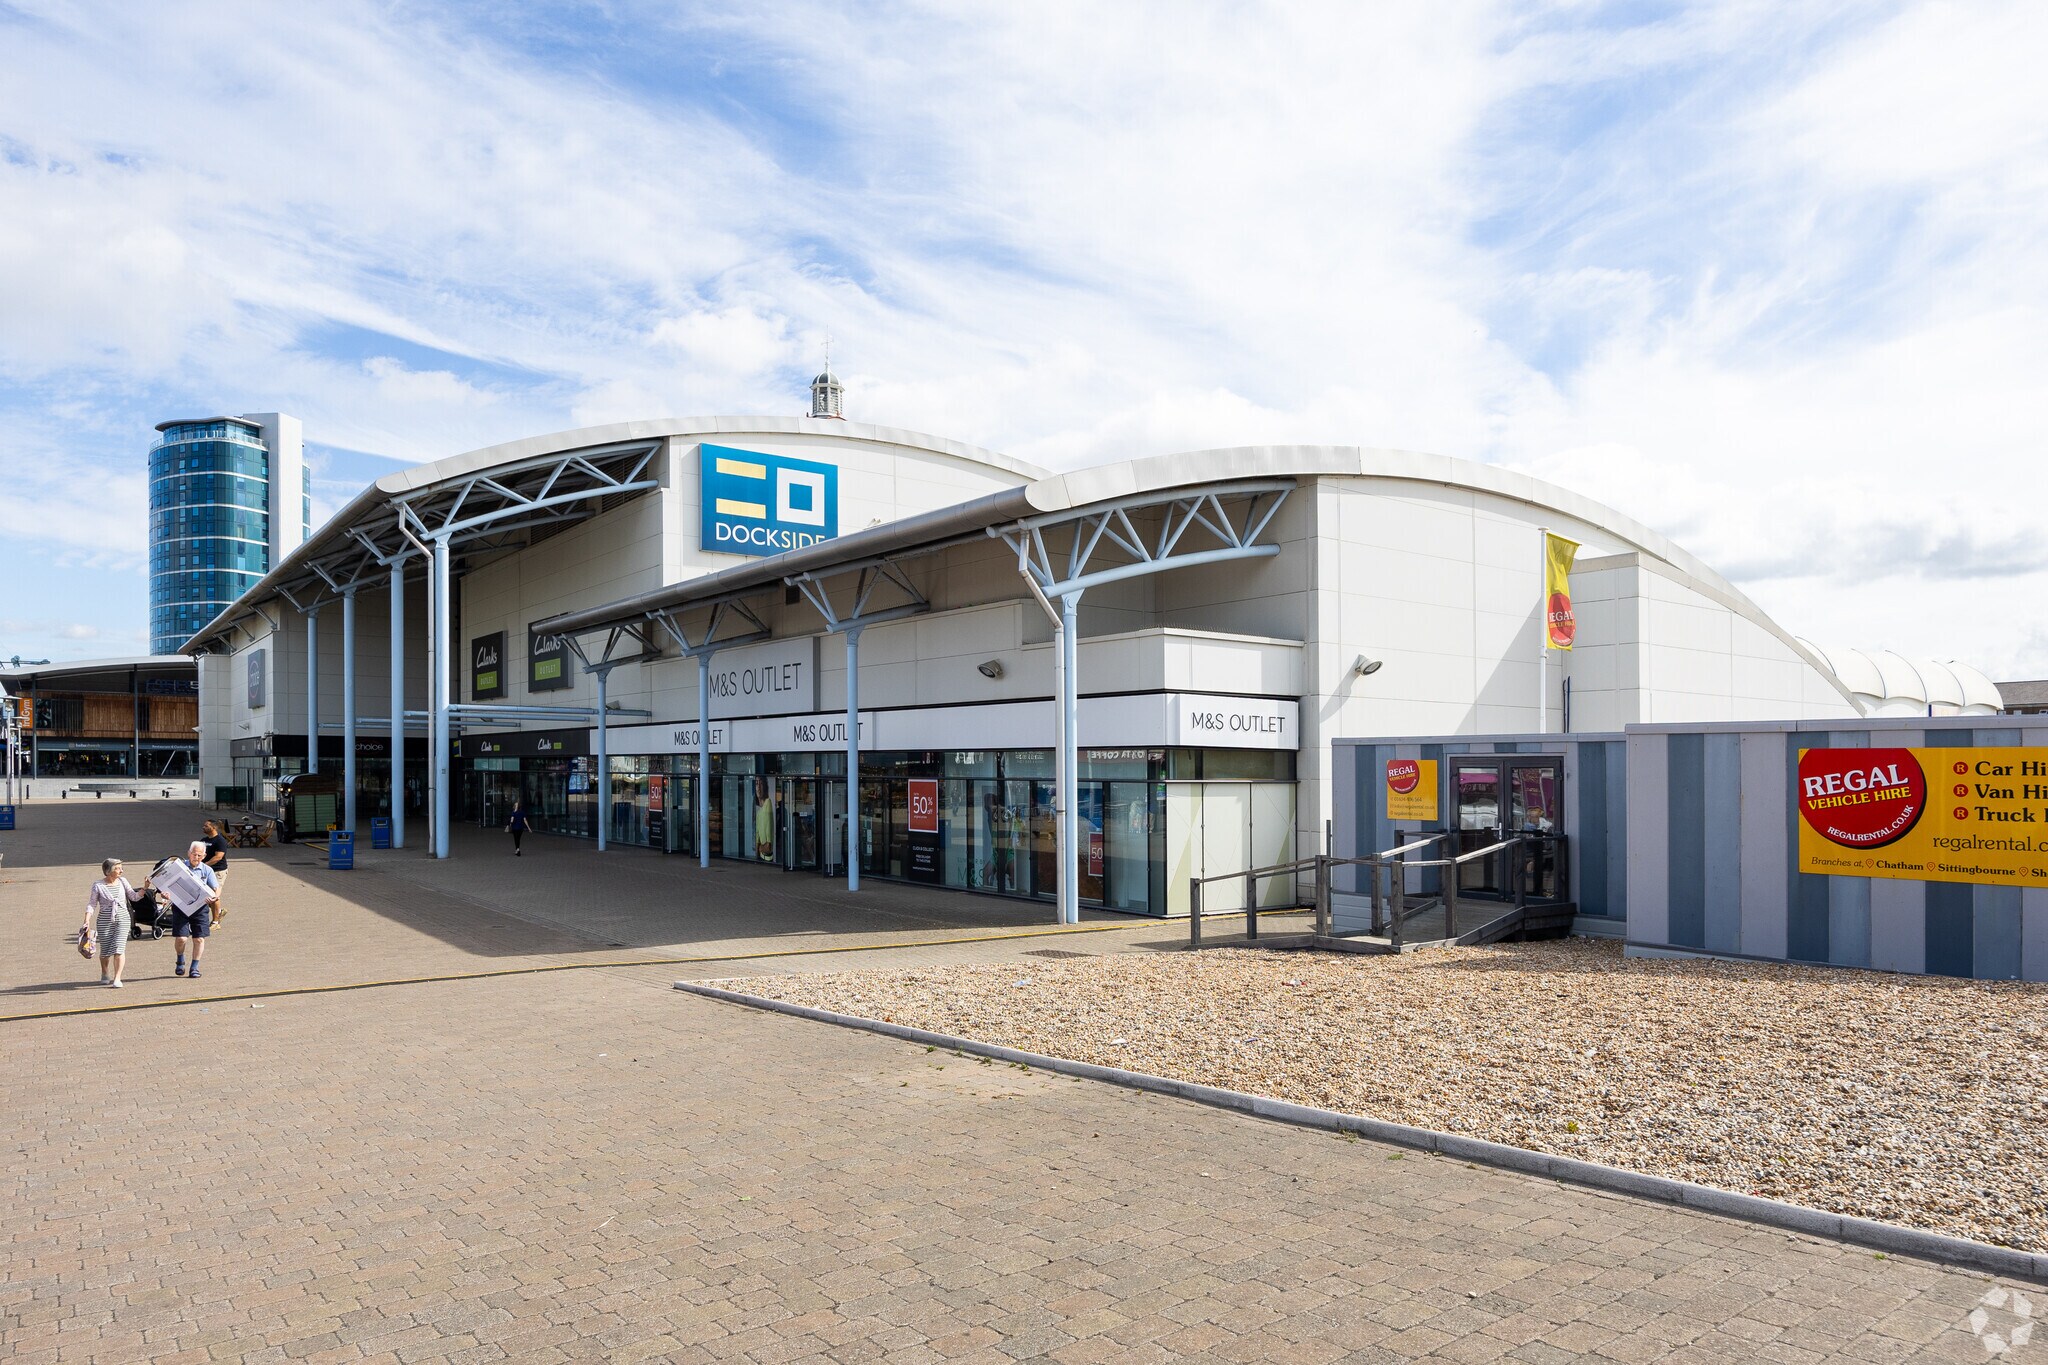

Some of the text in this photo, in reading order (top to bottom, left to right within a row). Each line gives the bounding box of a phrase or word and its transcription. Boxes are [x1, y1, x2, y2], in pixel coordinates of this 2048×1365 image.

[534, 635, 561, 656] Clarks
[477, 646, 497, 668] Clarks
[539, 664, 556, 674] OUTLET
[709, 662, 802, 698] M&S OUTLET
[1192, 712, 1286, 733] M&S OUTLET
[674, 729, 723, 746] M&S OLET
[794, 722, 864, 743] M&S OUTLT
[355, 743, 384, 751] choice
[1388, 765, 1415, 777] REGAL
[1975, 761, 2013, 776] Car
[2021, 761, 2048, 776] Hi
[1803, 764, 1908, 797] REGAL
[1808, 786, 1912, 810] VEHICLE HIRE
[1974, 784, 2014, 799] Van
[1827, 804, 1915, 841] REGALRENTAL.CO.UK
[1974, 806, 2036, 822] Truck
[1811, 857, 1851, 867] Branches
[1876, 860, 1924, 871] Chatham
[1938, 863, 2016, 875] Sittingbourne
